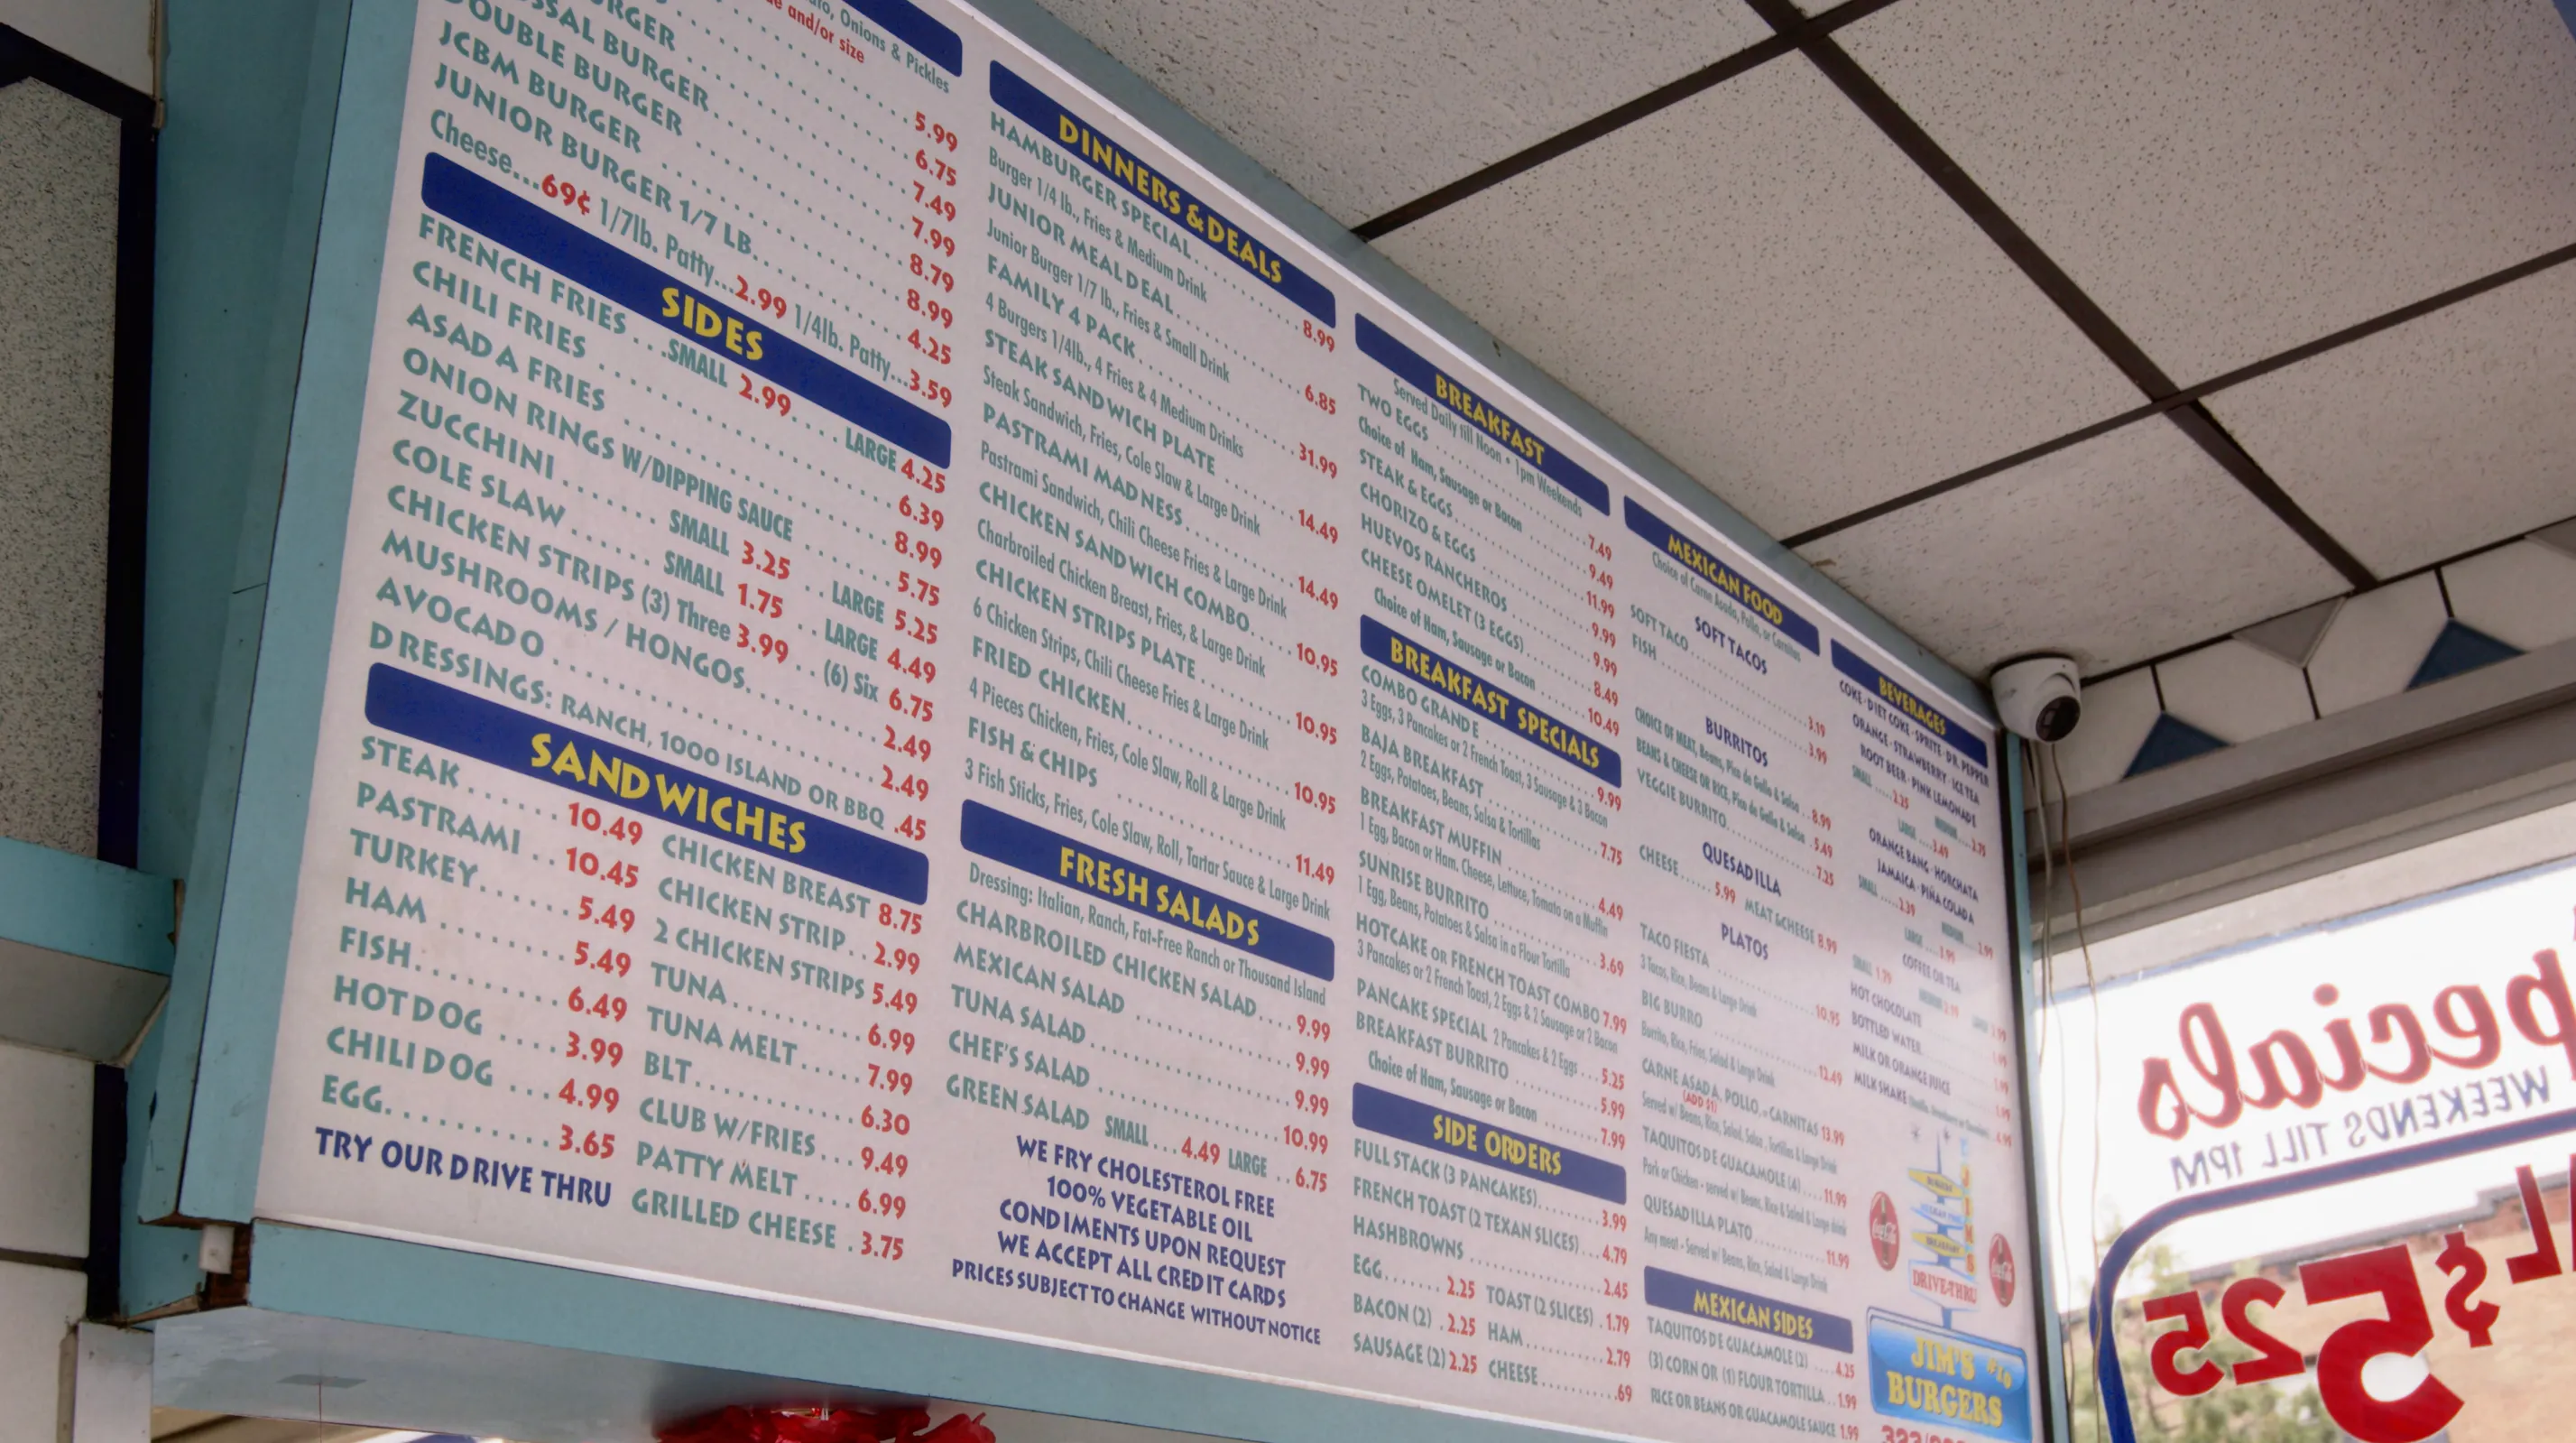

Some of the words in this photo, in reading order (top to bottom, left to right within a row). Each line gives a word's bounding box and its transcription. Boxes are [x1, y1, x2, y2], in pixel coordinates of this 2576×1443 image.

[788, 5, 835, 44] and/or
[839, 38, 864, 64] size
[840, 7, 886, 52] Onions
[891, 42, 901, 63] &
[906, 51, 949, 94] Pickles
[915, 111, 958, 153] 5.99
[434, 62, 553, 147] JUNIOR
[560, 131, 672, 213] BURGER
[679, 199, 718, 236] 1/7
[723, 222, 752, 254] LB
[907, 328, 952, 365] 4.25
[989, 145, 1033, 190] Burger
[1037, 176, 1057, 207] 1/4
[1084, 207, 1112, 241] Fries
[1114, 228, 1124, 250] &
[1127, 235, 1174, 282] Medium
[1177, 267, 1207, 303] Drink
[990, 110, 1118, 211] HAMBURGER
[1121, 199, 1192, 260] SPECIAL
[1303, 319, 1335, 353] 8.99
[1060, 116, 1180, 214] DINNERS
[1186, 204, 1204, 232] &
[1208, 217, 1281, 282] DEALS
[662, 287, 762, 359] SIDES
[987, 253, 1066, 316] FAMILY
[1068, 305, 1081, 327] 4
[1086, 313, 1136, 359] PACK
[1299, 441, 1338, 480] 31.99
[412, 260, 498, 319] CHILI
[507, 301, 586, 358] FRIES
[899, 494, 945, 532] 6.39
[983, 364, 1020, 402] Steak
[1023, 386, 1086, 443] Sandwich,
[1090, 423, 1122, 463] Fries,
[1125, 445, 1152, 476] Cole
[1154, 460, 1182, 492] Slaw
[1184, 478, 1194, 499] &
[1196, 483, 1228, 519] Large
[1231, 503, 1260, 536] Drink
[1393, 376, 1428, 416] Served
[1431, 401, 1457, 439] Daily
[1459, 423, 1473, 445] till
[1475, 432, 1502, 465] Noon
[1515, 458, 1536, 487] 1pm
[1537, 472, 1583, 518] Weekends
[1436, 375, 1544, 464] BREAKFAST
[1357, 382, 1392, 418] TWO
[1395, 407, 1429, 442] EGGS
[1587, 533, 1612, 562] 7.49
[386, 484, 531, 561] CHICKEN
[538, 544, 635, 602] STRIPS
[642, 583, 670, 622] (3)
[676, 597, 732, 642] Three
[736, 623, 789, 664] 3.99
[823, 658, 849, 694] (6)
[853, 671, 879, 703] Six
[889, 688, 934, 723] 6.75
[1361, 512, 1421, 562] HUEVOS
[1424, 550, 1508, 613] RANCHEROS
[1593, 651, 1618, 678] 9.99
[1668, 537, 1740, 594] MEXICAN
[1743, 585, 1783, 624] FOOD
[1373, 586, 1408, 620] Choice
[1409, 607, 1422, 627] of
[1452, 629, 1493, 668] Sausage
[1494, 658, 1506, 674] or
[1508, 661, 1536, 691] Bacon
[1587, 707, 1620, 737] 10.49
[1391, 638, 1508, 719] BREAKFAST
[1519, 708, 1599, 767] SPECIALS
[1630, 604, 1657, 633] SOFT
[1658, 621, 1689, 652] TACO
[1807, 716, 1826, 738] 3.19
[1694, 615, 1726, 649] SOFT
[1727, 635, 1768, 675] TACOS
[368, 620, 552, 709] DRESSINGS:
[560, 693, 652, 748] RANCH,
[660, 730, 720, 767] 1000
[725, 753, 802, 797] ISLAND
[808, 784, 839, 812] OR
[844, 796, 885, 831] BBQ
[1705, 716, 1768, 768] BURRITOS
[361, 735, 460, 789] STEAK
[568, 802, 643, 846] 10.49
[532, 734, 805, 853] SANDWICHES
[1362, 723, 1400, 759] BAJA
[1403, 744, 1484, 799] BREAKFAST
[1600, 841, 1622, 866] 7.75
[1637, 767, 1676, 802] VEGGIE
[1678, 790, 1727, 828] BURRITO
[1815, 865, 1834, 887] 7.25
[661, 834, 776, 890] CHICKEN
[782, 870, 871, 919] BREAST
[878, 902, 922, 935] 8.75
[969, 861, 1033, 907] Dressing:
[1038, 885, 1085, 925] Italian,
[1087, 903, 1129, 941] Ranch,
[1186, 939, 1221, 969] Ranch
[1223, 958, 1236, 975] or
[1238, 957, 1291, 994] Thousand
[1293, 977, 1326, 1006] Island
[1060, 847, 1148, 906] FRESH
[1157, 885, 1259, 946] SALADS
[1358, 874, 1363, 894] 1
[1423, 902, 1463, 935] Potatoes
[1464, 920, 1473, 939] &
[1473, 923, 1498, 950] Salsa
[1500, 934, 1509, 954] in
[1510, 943, 1517, 957] a
[1519, 941, 1541, 967] Flour
[1541, 950, 1571, 979] Tortilla
[953, 941, 1057, 994] MEXICAN
[1061, 976, 1125, 1014] SALAD
[1296, 1051, 1330, 1080] 9.99
[315, 1125, 373, 1162] TRY
[381, 1140, 443, 1177] OUR
[449, 1153, 533, 1194] DRIVE
[540, 1170, 612, 1208] THRU
[1016, 1134, 1048, 1163] WE
[1054, 1143, 1094, 1173] FRY
[1097, 1156, 1230, 1207] CHOLESTEROL
[1234, 1189, 1275, 1218] FREE
[1434, 1115, 1476, 1151] SIDE
[1484, 1132, 1561, 1175] ORDERS
[1047, 1175, 1106, 1208] 100%
[1111, 1189, 1217, 1235] VEGETABLE
[1222, 1216, 1253, 1243] OIL
[1353, 1214, 1463, 1261] HASHBROWNS
[1603, 1277, 1629, 1300] 2.45
[1717, 1216, 1753, 1242] PLATO
[1825, 1249, 1851, 1270] 11.99
[1694, 1293, 1770, 1327] MEXICAN
[1773, 1310, 1813, 1338] SIDES
[1887, 1370, 2004, 1429] BURGERS
